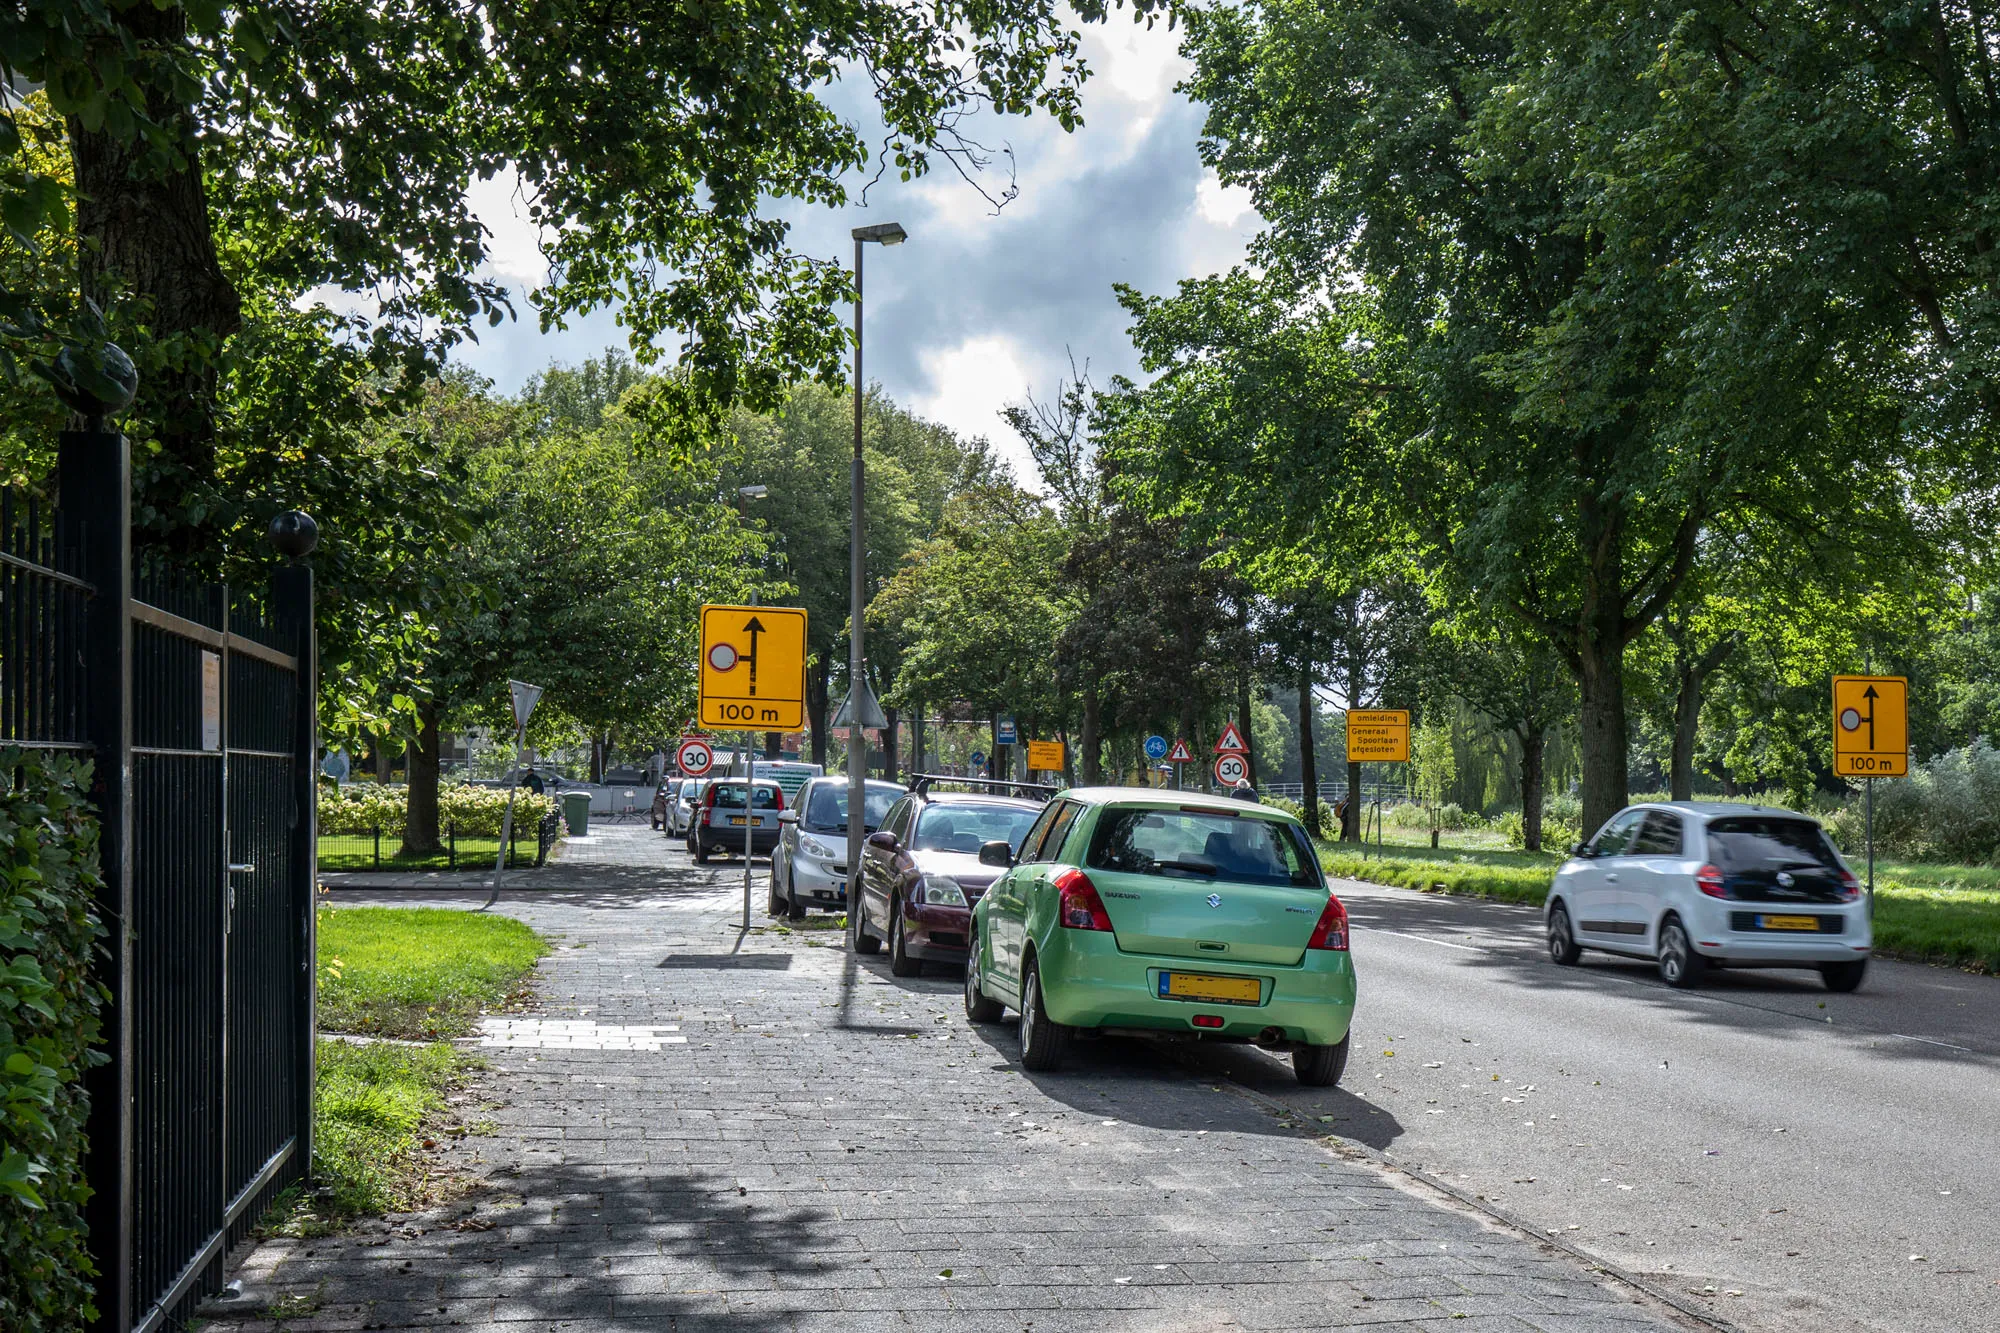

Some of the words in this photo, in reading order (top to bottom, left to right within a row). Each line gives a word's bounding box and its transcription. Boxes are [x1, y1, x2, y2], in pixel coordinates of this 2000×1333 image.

[719, 704, 754, 720] 100
[761, 709, 778, 721] m
[1357, 715, 1398, 723] omleiding
[1351, 746, 1395, 754] afgesloten
[685, 752, 707, 766] 30
[1850, 757, 1875, 770] 100
[1879, 760, 1892, 771] m
[1221, 762, 1243, 775] 30
